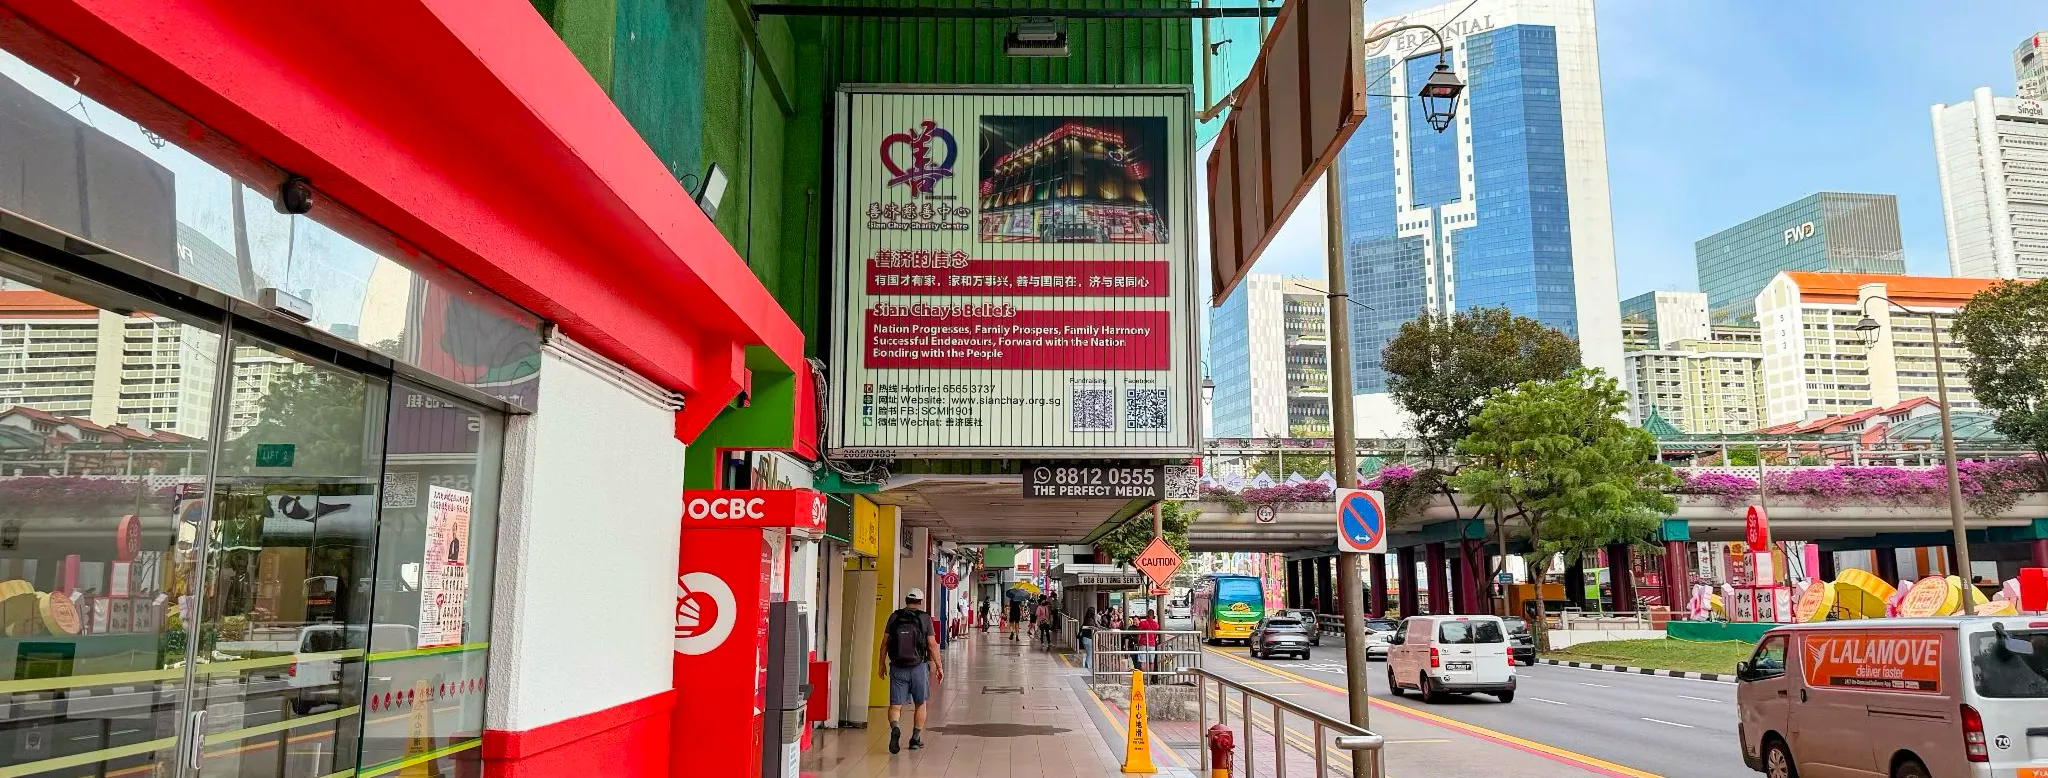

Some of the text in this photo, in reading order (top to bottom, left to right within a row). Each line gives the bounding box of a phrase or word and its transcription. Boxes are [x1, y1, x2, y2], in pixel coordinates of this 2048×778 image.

[2018, 105, 2043, 116] Singtel
[1784, 221, 1815, 245] FWD
[874, 302, 907, 318] Sian
[963, 302, 1016, 318] Beliefs
[873, 324, 1150, 337] Nation Progresses, Family Prospers, Family Harmony
[873, 335, 1126, 348] Successful Endeavours, Forward with the Nation
[873, 347, 1003, 360] Bonding with the People
[900, 384, 940, 393] Hotline:
[942, 385, 968, 393] 6565
[971, 385, 996, 393] 3737
[900, 395, 945, 404] Website:
[951, 396, 1061, 407] www.sianchay.org.sg
[900, 407, 919, 415] FB:
[899, 418, 942, 427] Wechat:
[262, 450, 280, 460] LIFT
[1055, 467, 1156, 486] 8812 0555
[1033, 485, 1156, 497] THE PERFECT MEDIA
[688, 497, 765, 520] OCBC
[1141, 557, 1176, 567] CAUTION
[1830, 638, 1939, 666] LALAMOVE
[1856, 665, 1905, 679] deliver faster
[1996, 737, 2010, 746] 70
